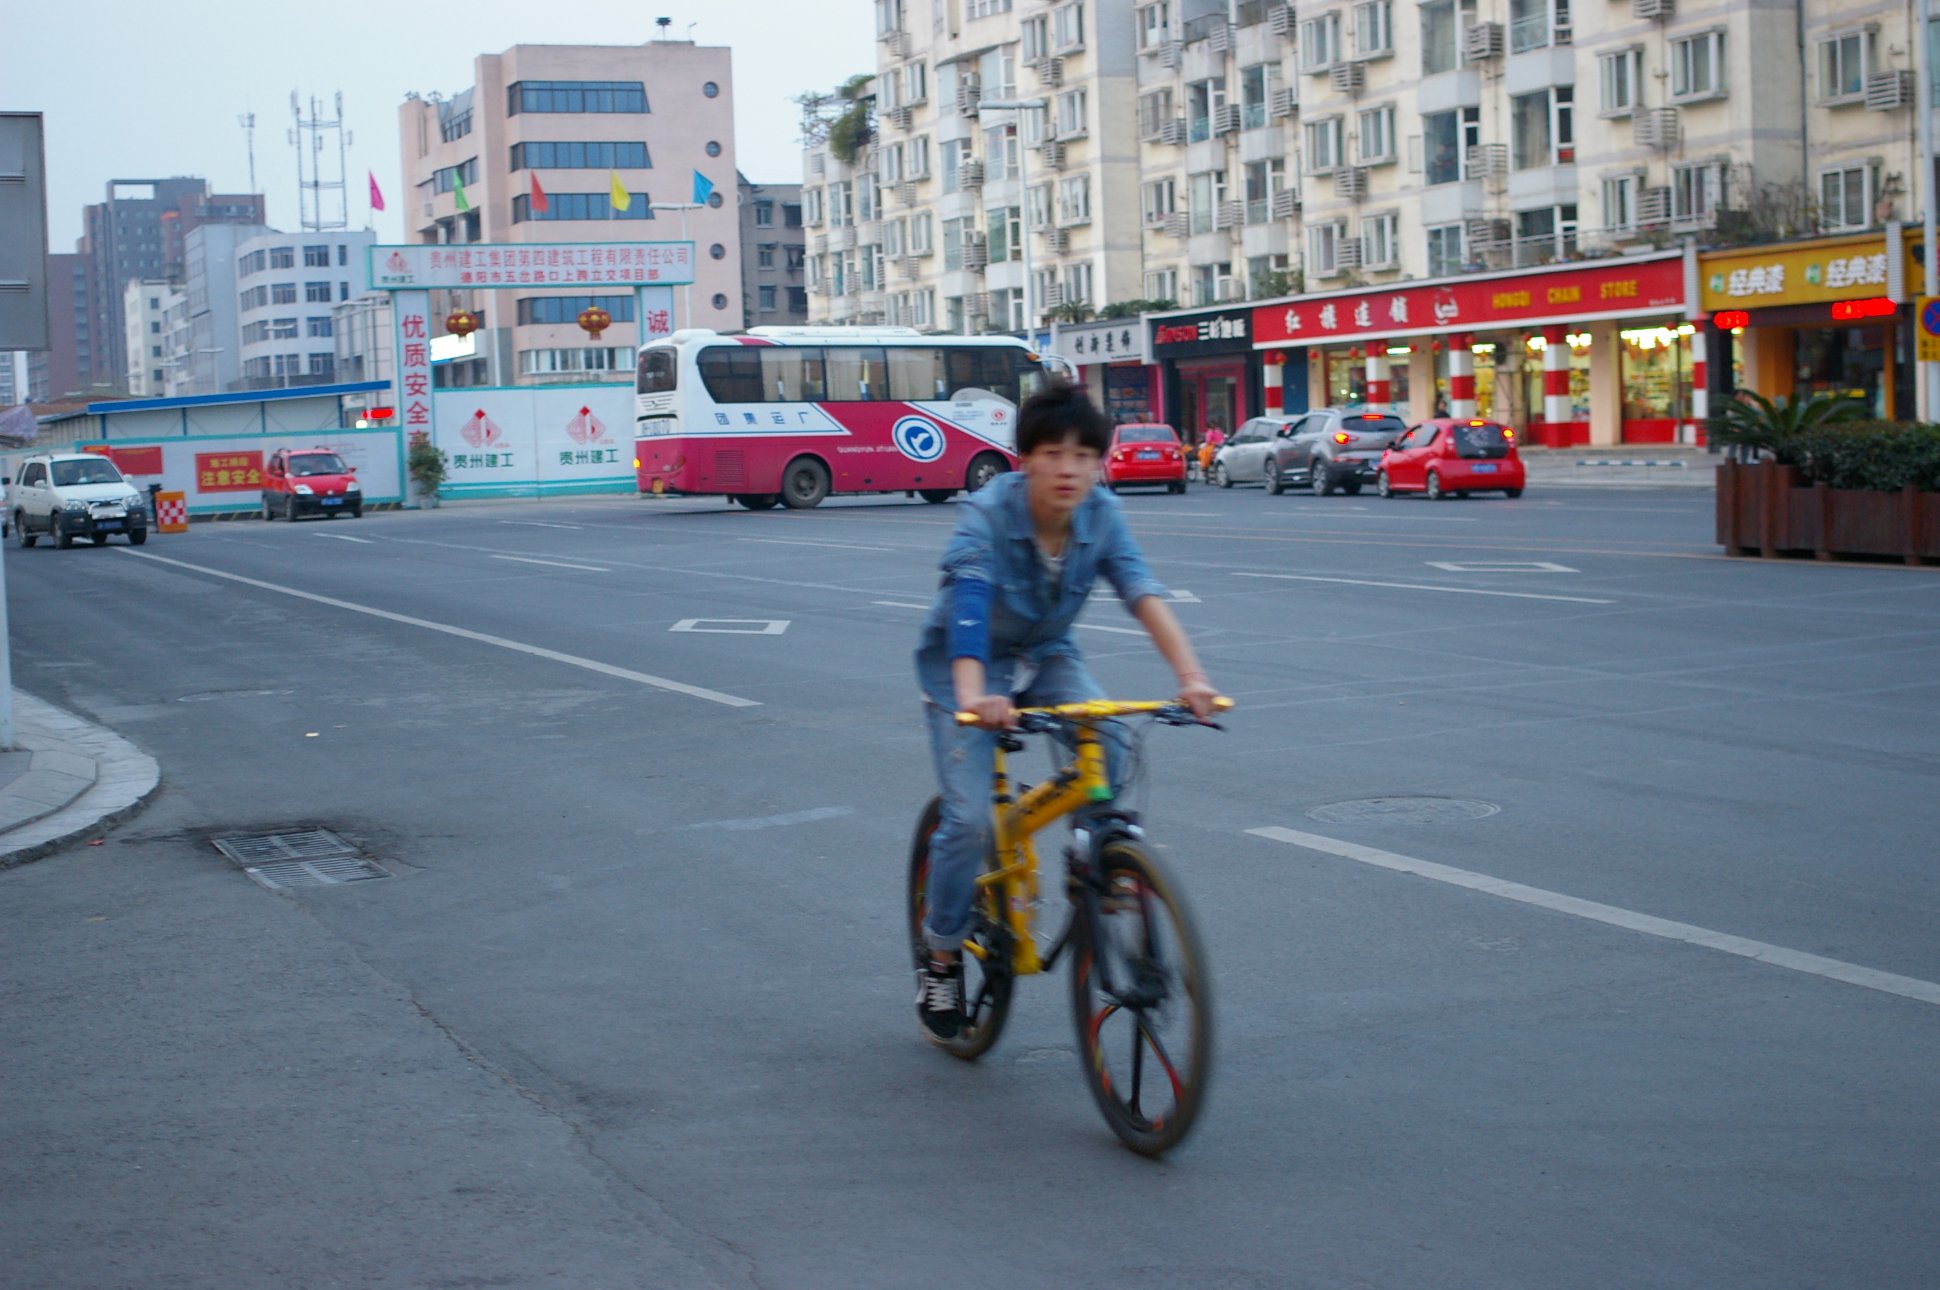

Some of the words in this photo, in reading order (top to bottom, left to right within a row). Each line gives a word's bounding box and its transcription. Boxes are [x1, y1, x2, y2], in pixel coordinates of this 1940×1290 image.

[1547, 286, 1581, 304] CHAIN
[1600, 280, 1638, 299] STORE
[647, 310, 669, 333] 诚
[1284, 296, 1409, 334] 红旗连锁
[454, 453, 514, 469] 贵州建工
[560, 449, 619, 466] 贵州建工
[201, 467, 261, 487] 注意安全
